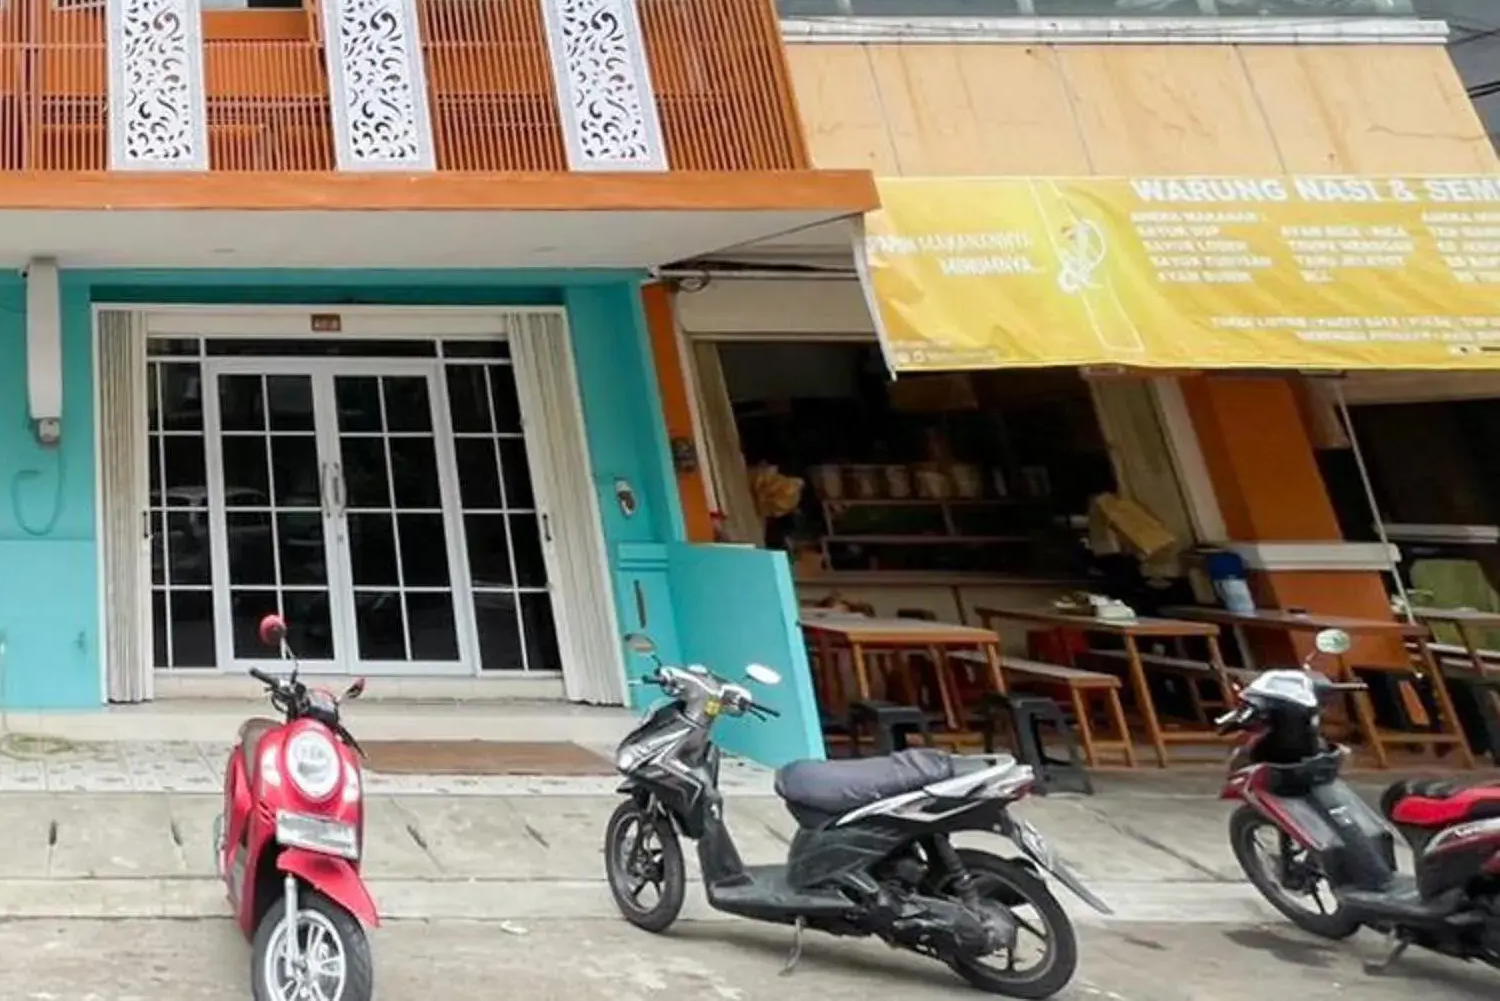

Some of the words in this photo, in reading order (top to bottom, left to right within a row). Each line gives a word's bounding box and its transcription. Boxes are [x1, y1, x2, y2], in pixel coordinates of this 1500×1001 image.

[1130, 178, 1288, 202] WARUNG
[1293, 177, 1382, 202] NASI
[1388, 178, 1417, 202] &
[1424, 179, 1500, 202] SEM
